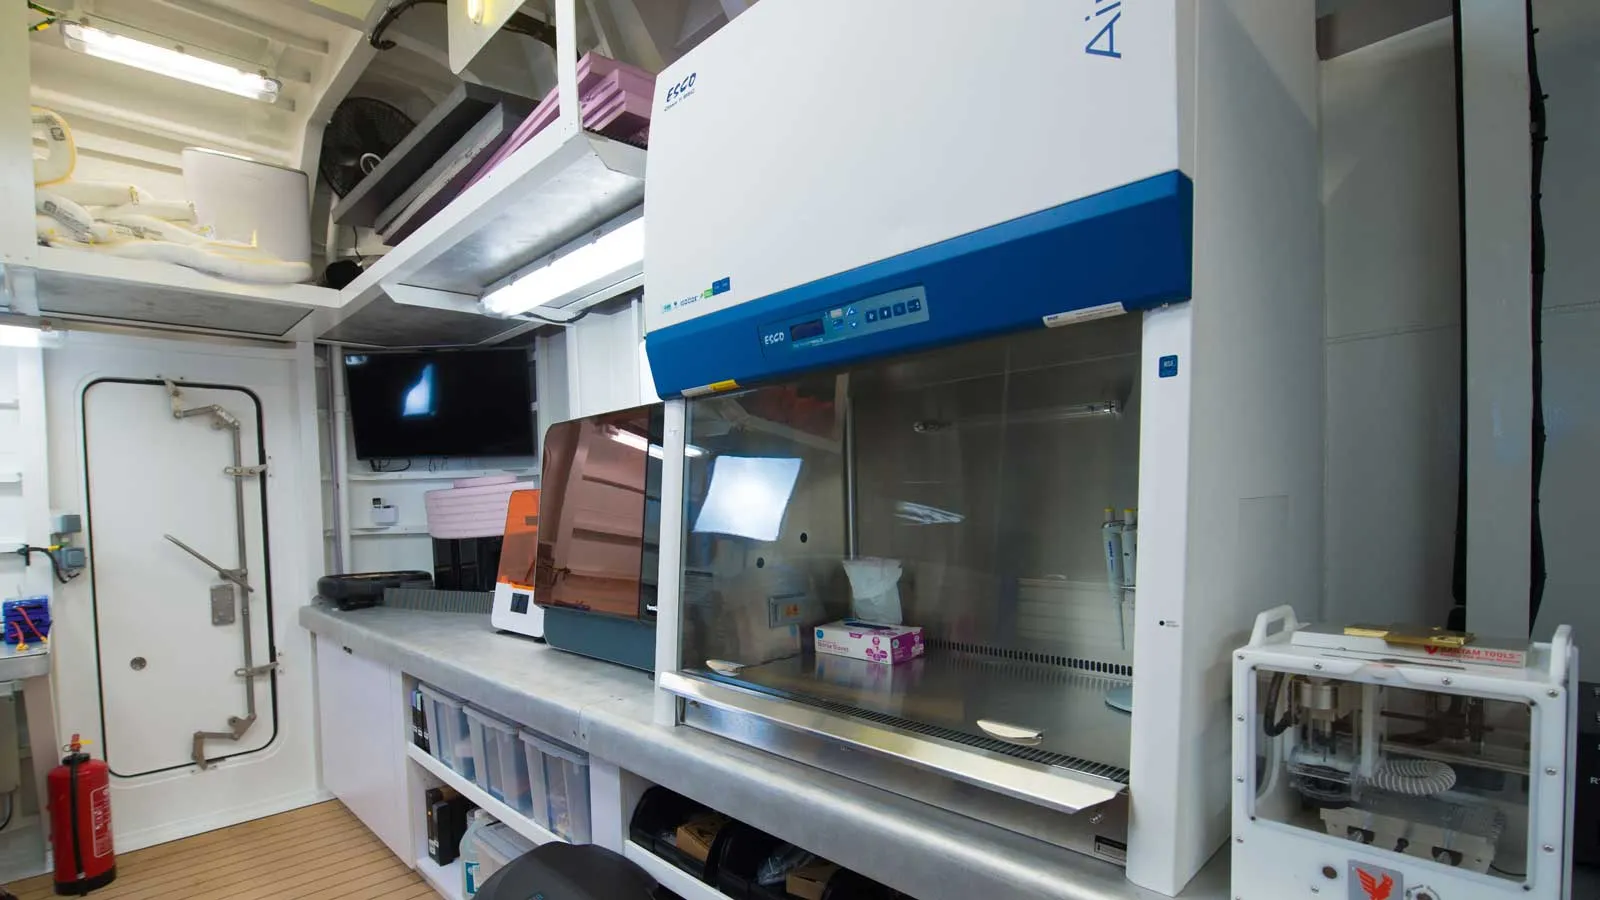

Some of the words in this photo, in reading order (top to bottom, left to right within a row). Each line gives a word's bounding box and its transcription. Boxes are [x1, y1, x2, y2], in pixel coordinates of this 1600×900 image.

[1085, 0, 1121, 58] Ai
[666, 72, 697, 102] ESCO
[764, 331, 785, 345] ESCO
